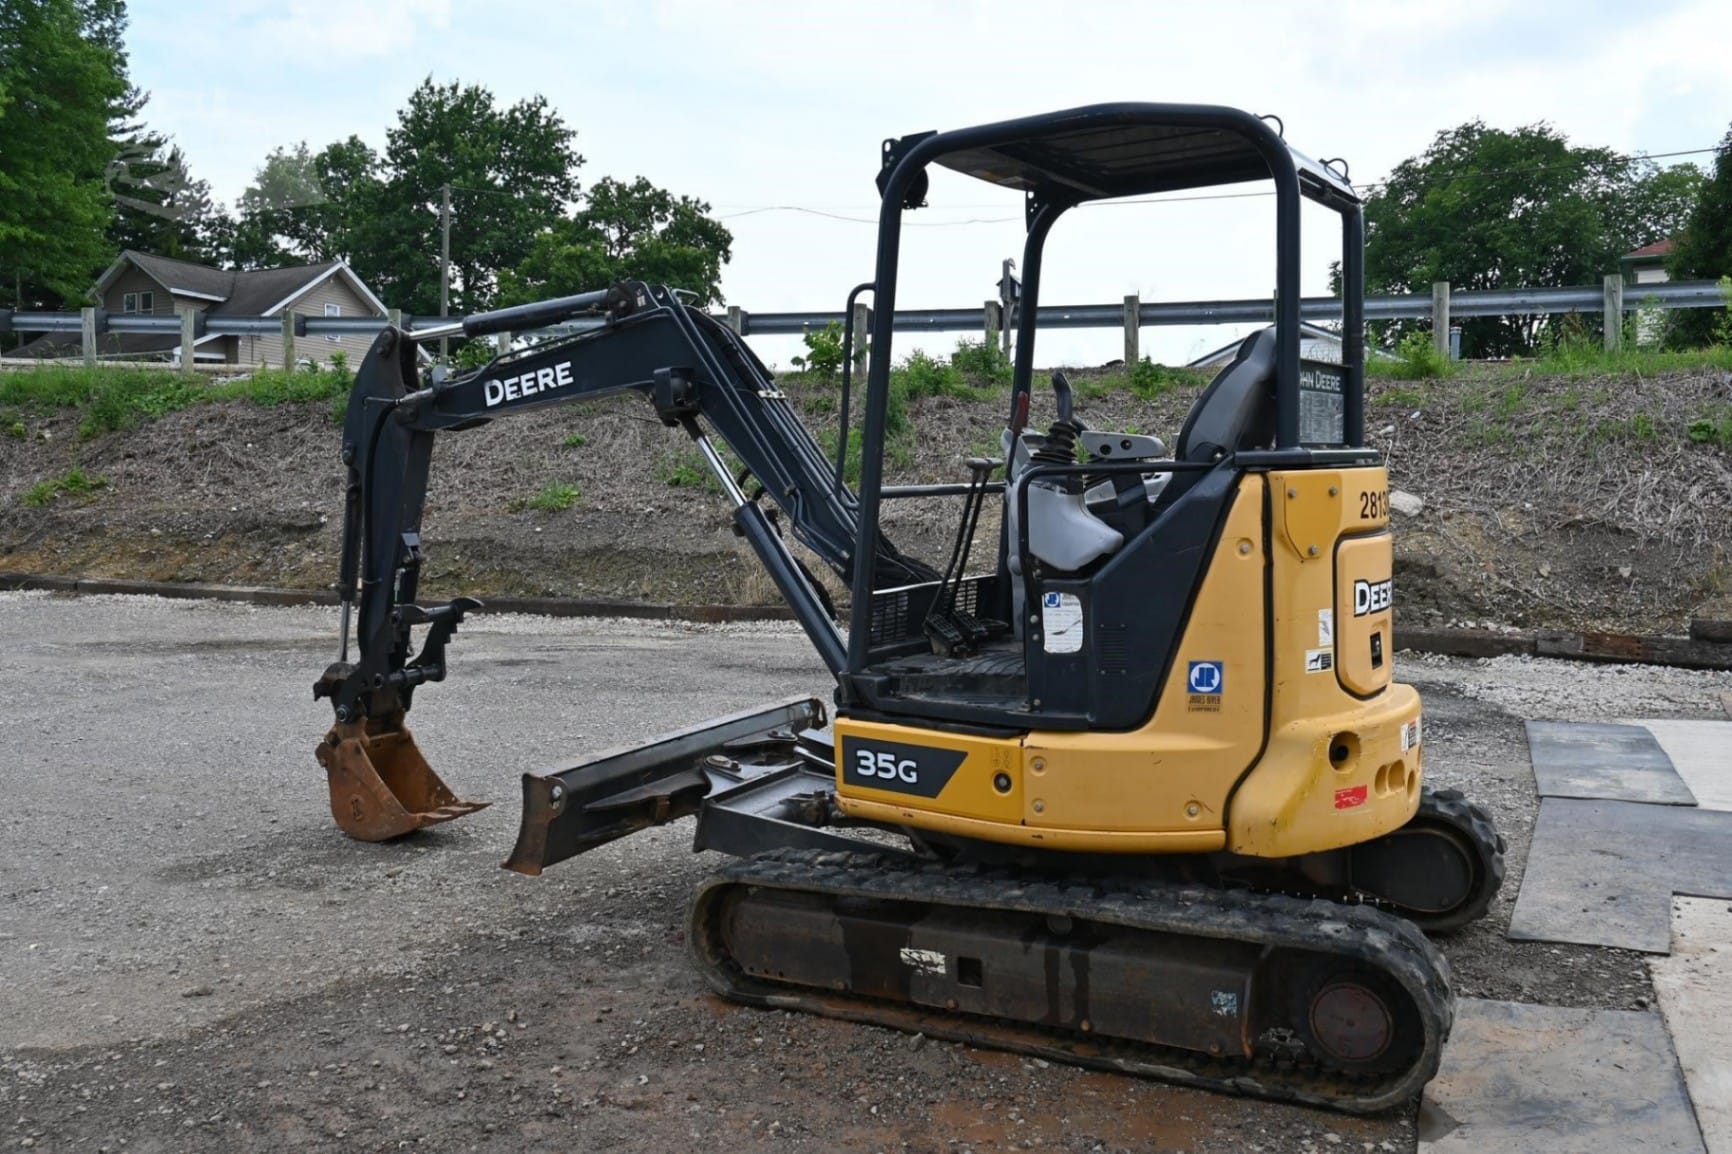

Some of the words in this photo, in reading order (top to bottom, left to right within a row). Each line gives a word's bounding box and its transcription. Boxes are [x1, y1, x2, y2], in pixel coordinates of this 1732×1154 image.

[484, 361, 574, 407] DEERE
[1315, 370, 1341, 391] DEERE
[1360, 491, 1389, 519] 2813
[856, 749, 918, 783] 35G
